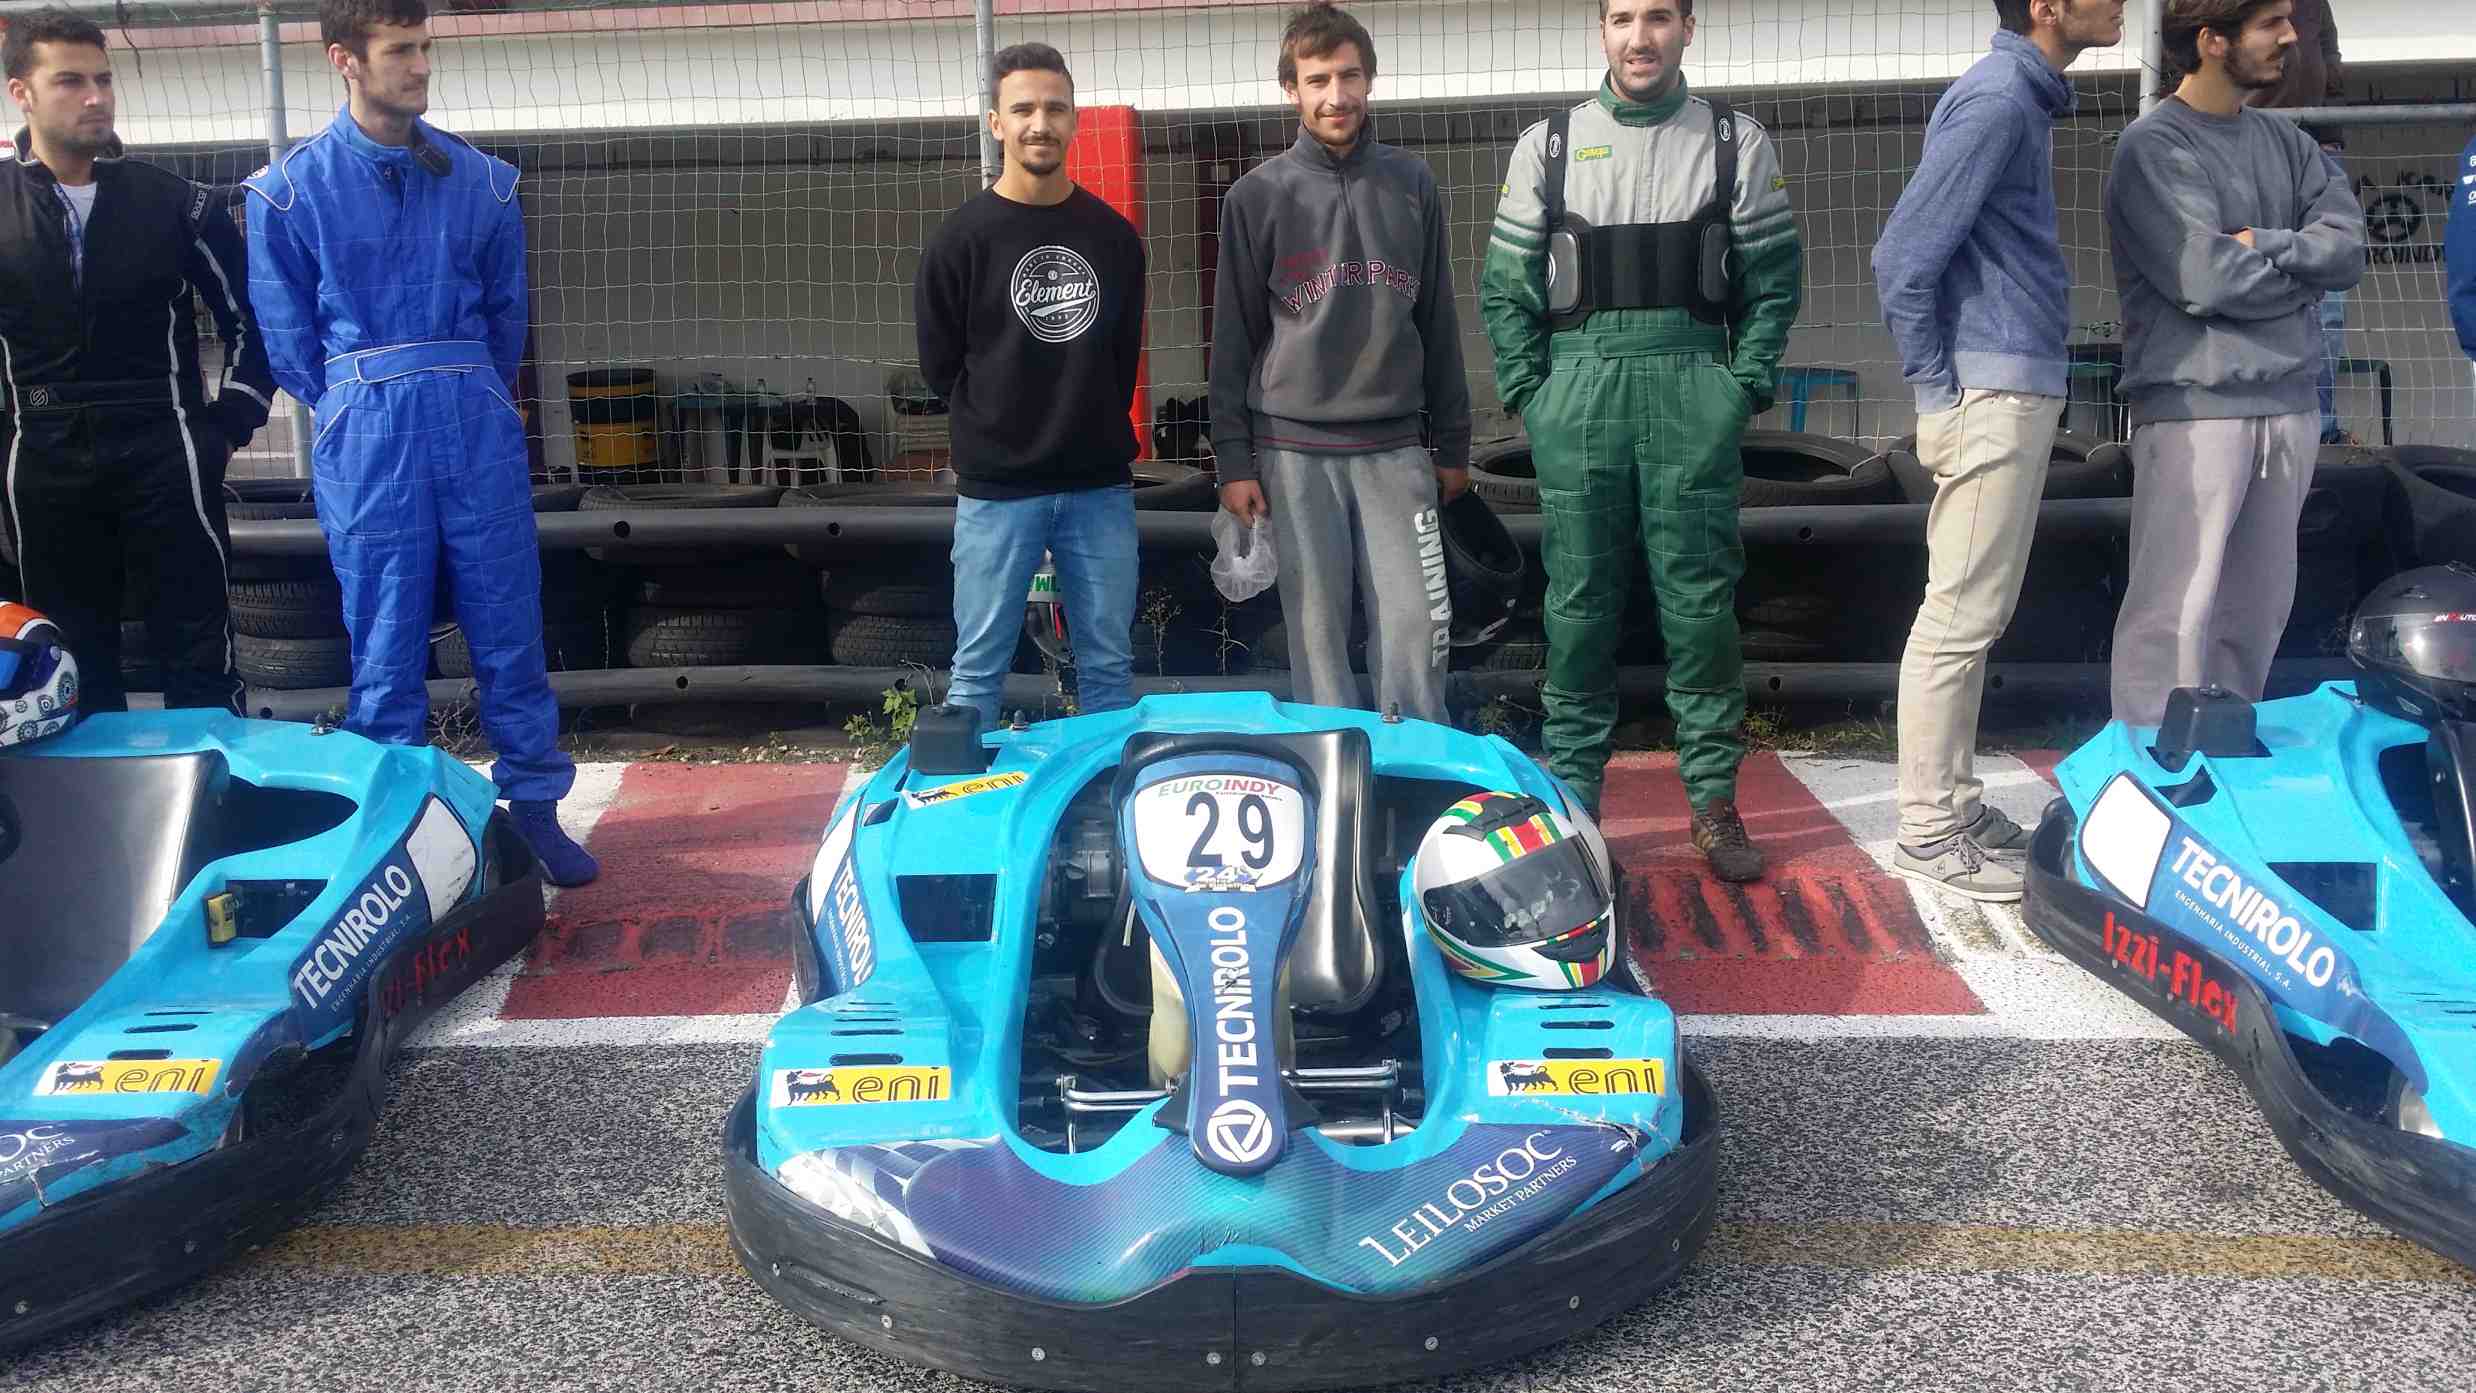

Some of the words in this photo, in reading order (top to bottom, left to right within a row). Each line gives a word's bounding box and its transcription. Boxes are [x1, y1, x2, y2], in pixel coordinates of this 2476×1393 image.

[1016, 279, 1094, 306] Element
[962, 774, 1025, 793] eni
[1158, 779, 1281, 797] EUROINDY
[1186, 792, 1274, 869] 29
[2172, 836, 2335, 988] TECNIROLO
[2175, 890, 2224, 935] ENGENHARIA
[294, 865, 412, 1009] TECNIROLO
[1208, 906, 1259, 1097] TECNIROLO
[115, 1059, 209, 1092] eni
[852, 1066, 940, 1103] eni
[1568, 1059, 1657, 1094] eni
[1358, 1131, 1562, 1267] LEILOSOC
[1463, 1194, 1518, 1233] MARKET
[1516, 1155, 1577, 1202] PARTNERS
